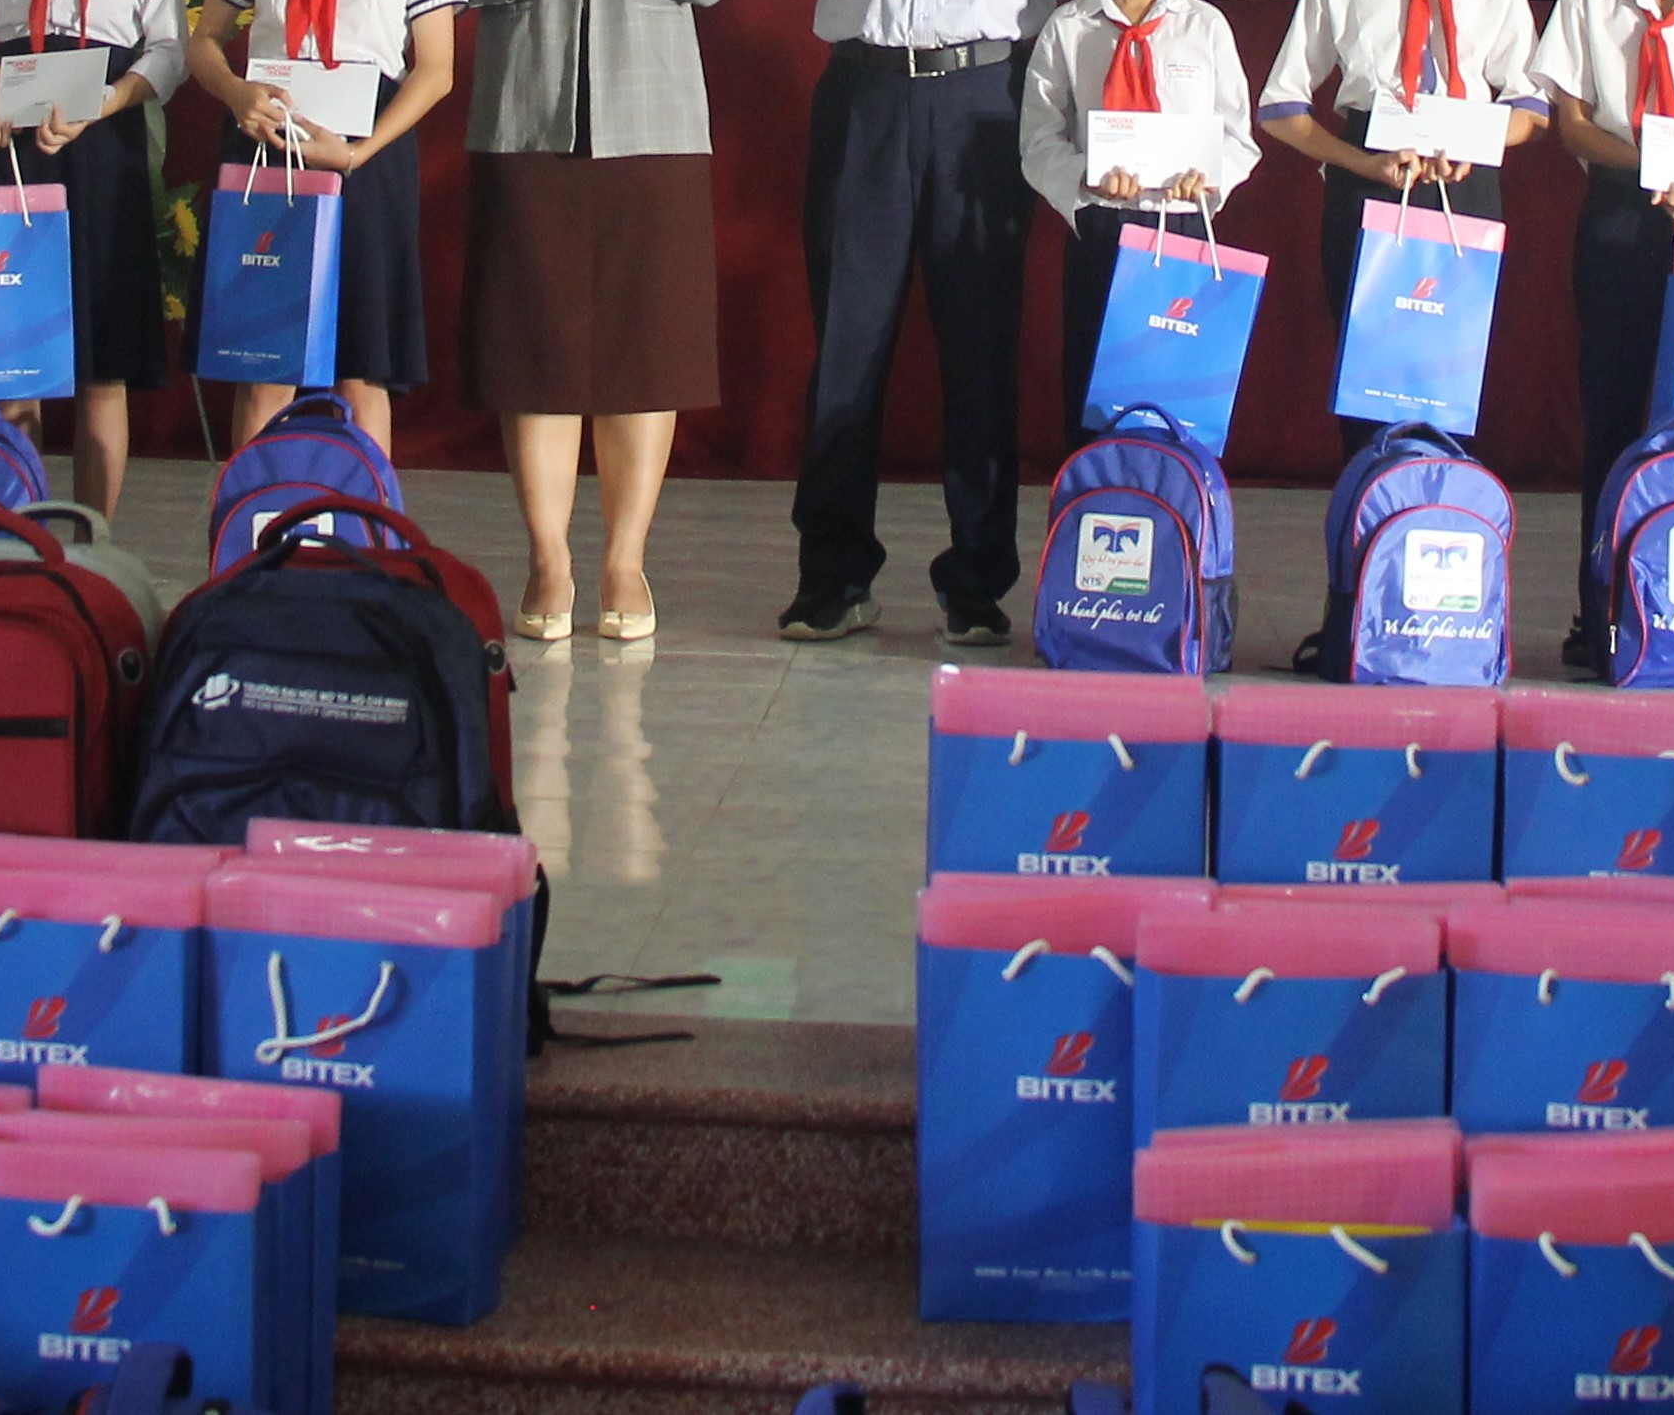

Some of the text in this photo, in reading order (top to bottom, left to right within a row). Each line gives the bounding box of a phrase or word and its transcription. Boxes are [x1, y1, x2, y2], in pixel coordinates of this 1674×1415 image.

[242, 254, 280, 266] BITEX
[1396, 297, 1444, 315] BITEX
[1149, 311, 1198, 336] BITEX
[1018, 854, 1111, 877] BITEX
[1306, 862, 1399, 884] BITEX
[281, 1059, 373, 1086] BITEX
[1017, 1076, 1113, 1102] BITEX
[1248, 1104, 1350, 1126] BITEX
[1547, 1104, 1648, 1129] BITEX
